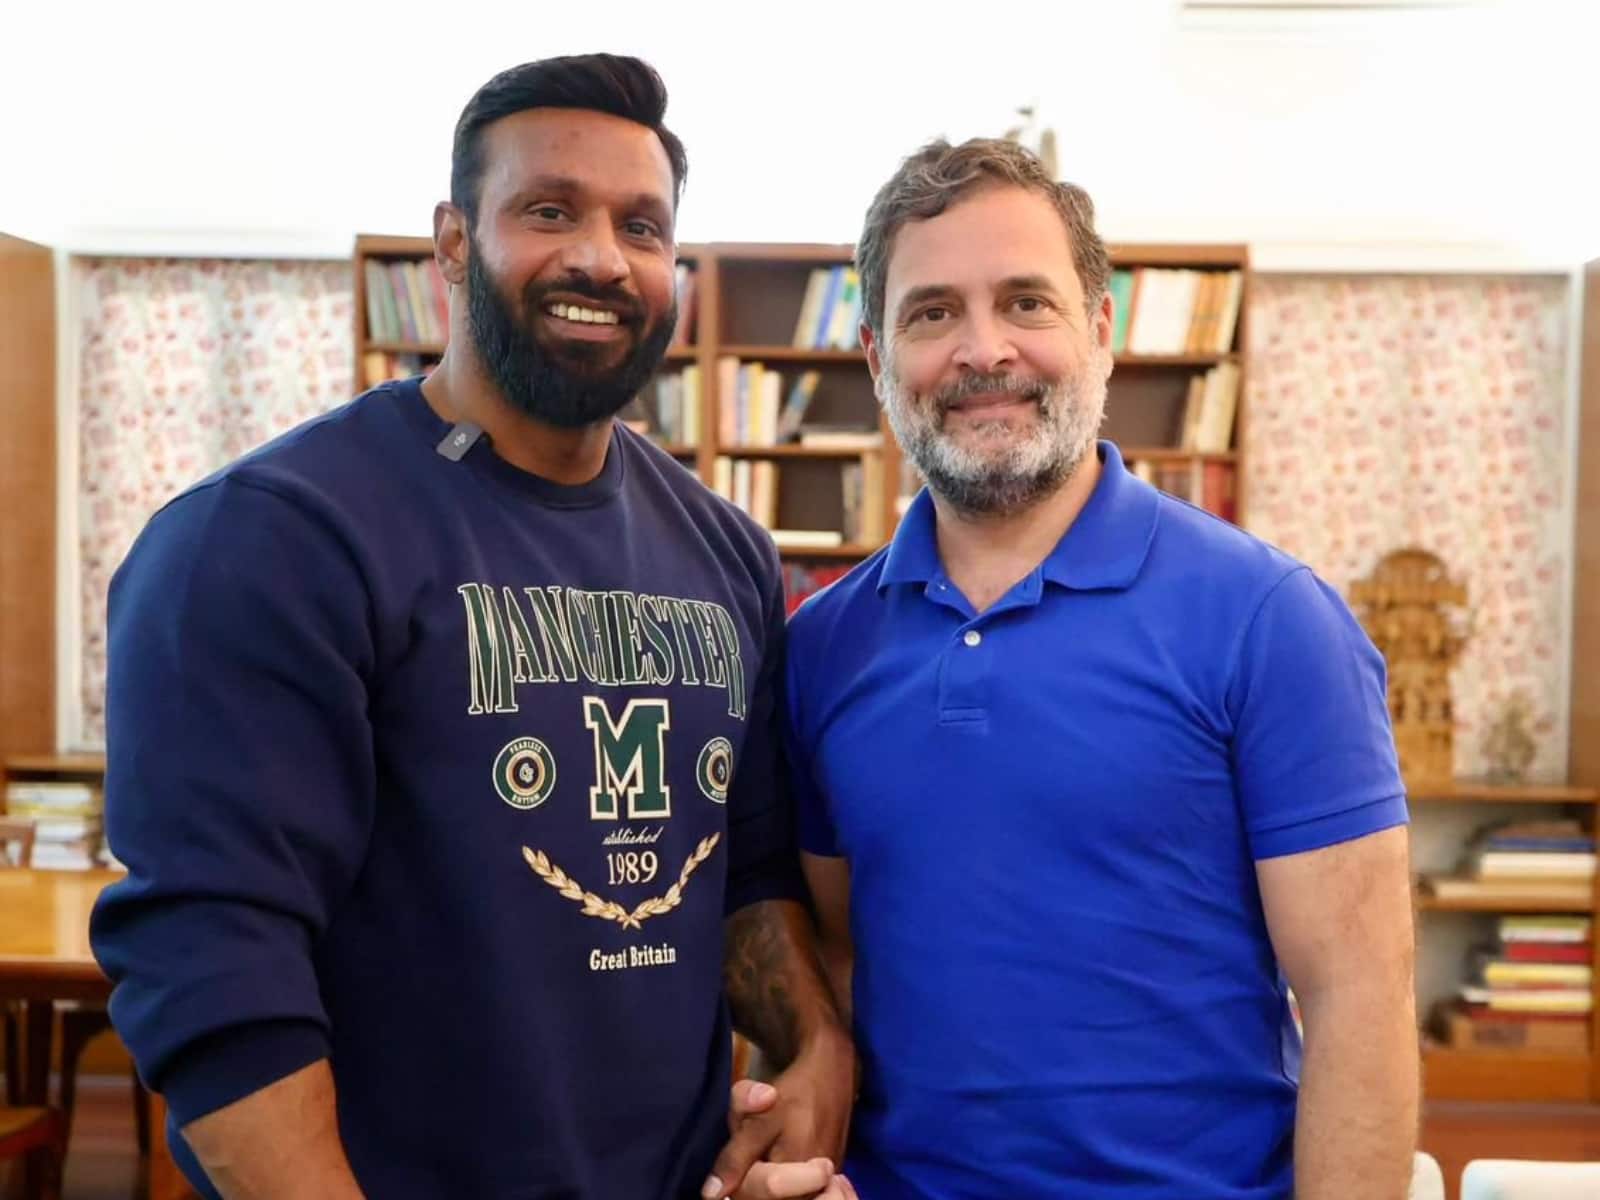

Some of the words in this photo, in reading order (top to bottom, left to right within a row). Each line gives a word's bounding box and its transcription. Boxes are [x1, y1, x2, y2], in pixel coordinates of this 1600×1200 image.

[457, 582, 746, 721] MANCHESTER
[582, 695, 671, 820] M
[607, 850, 658, 885] 1989
[589, 948, 628, 970] Great
[630, 943, 676, 967] Britain
